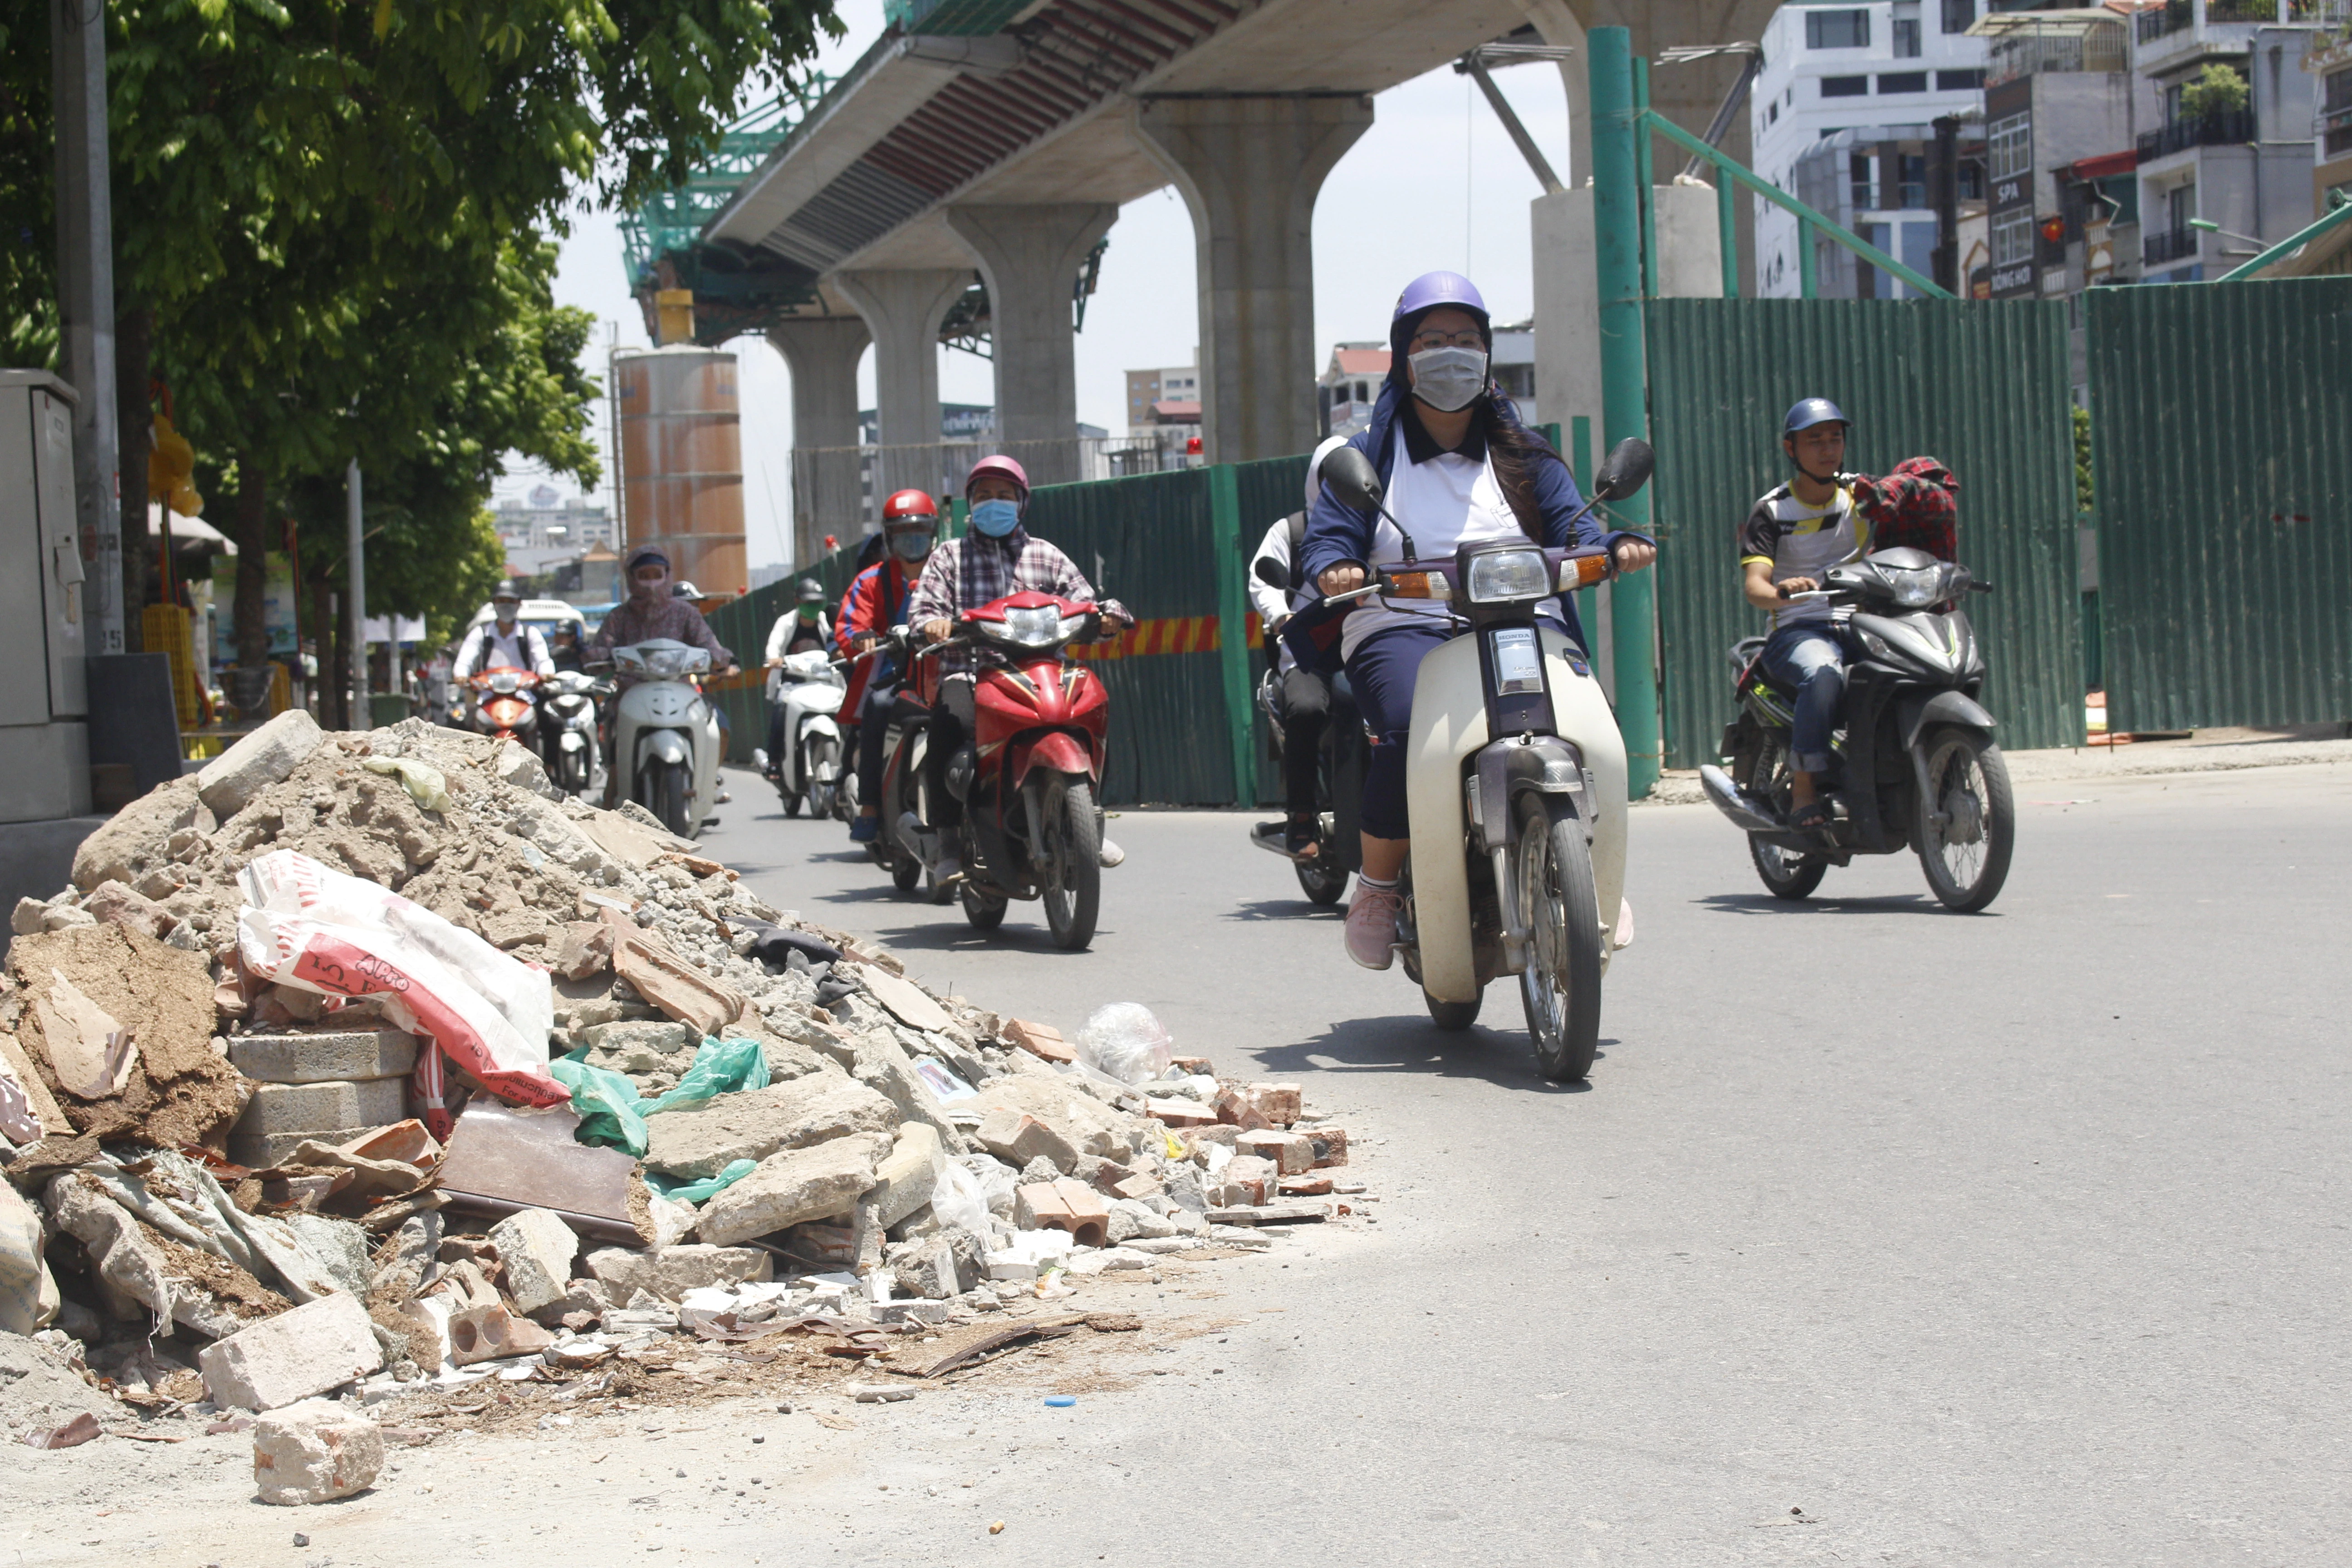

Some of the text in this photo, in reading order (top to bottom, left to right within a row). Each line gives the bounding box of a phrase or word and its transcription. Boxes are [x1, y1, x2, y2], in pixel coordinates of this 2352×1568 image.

[1998, 182, 2019, 204] SPA
[355, 954, 409, 992] APro
[502, 1084, 533, 1104] For all
